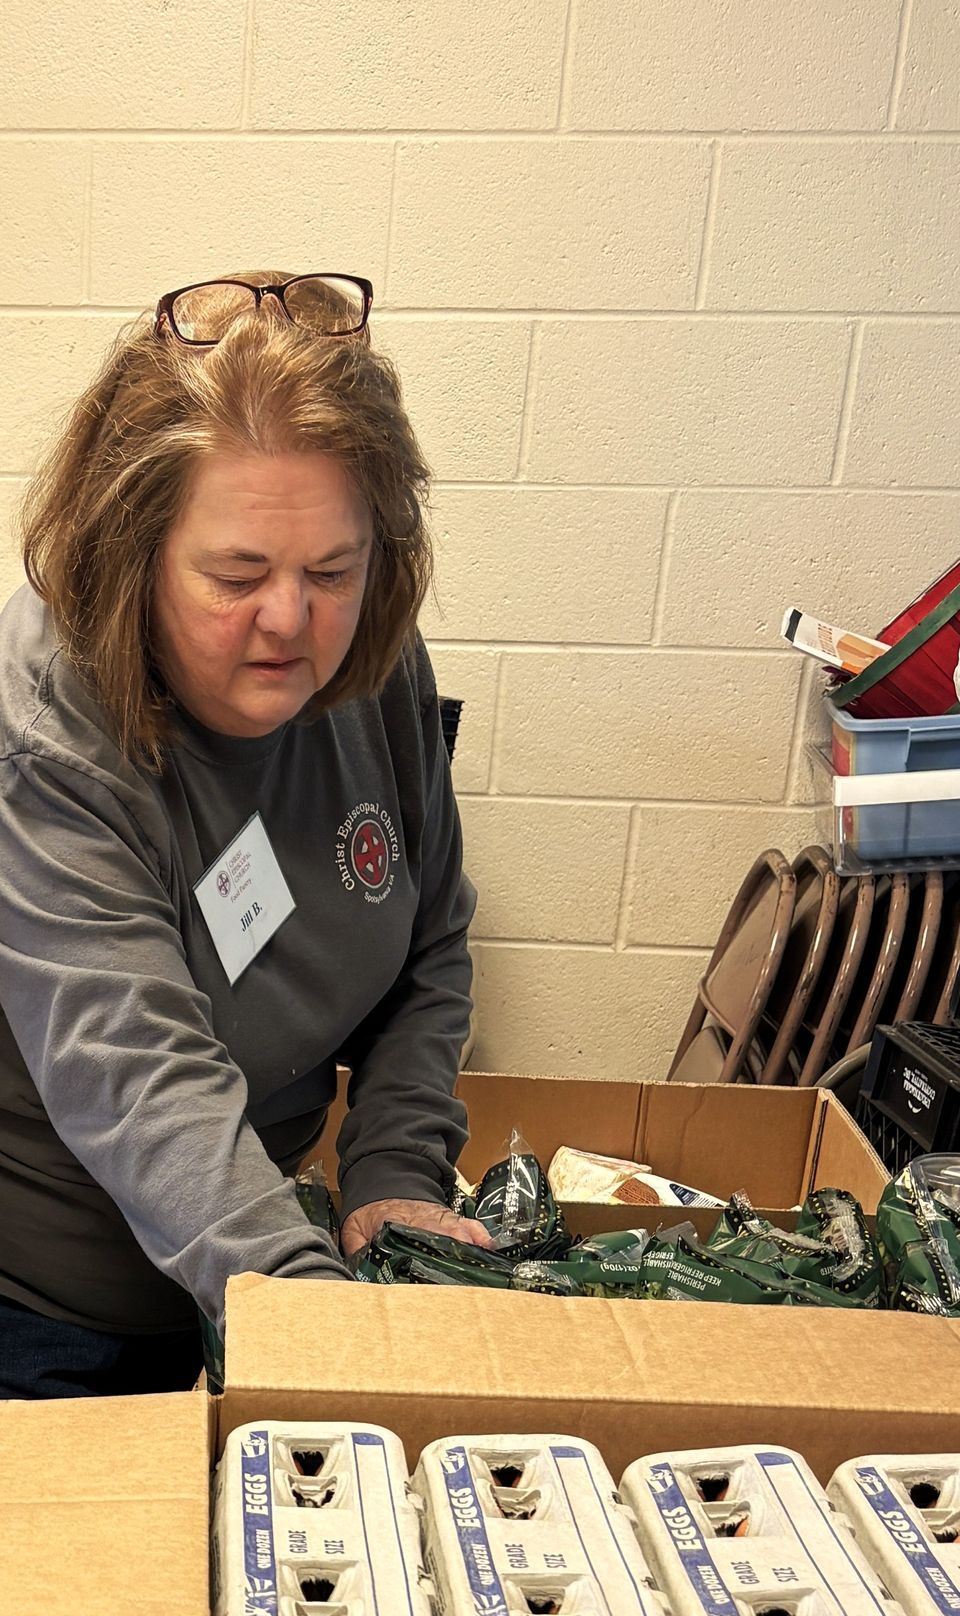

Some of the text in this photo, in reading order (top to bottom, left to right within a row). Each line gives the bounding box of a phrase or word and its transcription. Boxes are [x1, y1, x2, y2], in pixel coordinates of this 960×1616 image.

[335, 802, 400, 890] Christ Episcopal Church
[240, 901, 263, 932] Jill B.
[668, 1269, 706, 1291] PERISHABLE
[703, 1275, 722, 1287] KEEP
[244, 1472, 269, 1515] EGGS
[449, 1487, 482, 1528] EGGS
[661, 1506, 704, 1550] EGGS
[878, 1510, 928, 1554] EGGS
[256, 1529, 271, 1554] DOZEN
[288, 1529, 308, 1554] GRADE
[324, 1539, 345, 1555] SIZE
[471, 1543, 491, 1570] DOZEN
[506, 1543, 528, 1569] GRADE
[543, 1553, 568, 1569] SIZE
[696, 1565, 723, 1589] DOZEN
[731, 1560, 761, 1586] GRADE
[771, 1566, 800, 1584] SIZE
[924, 1567, 954, 1593] DOZEN
